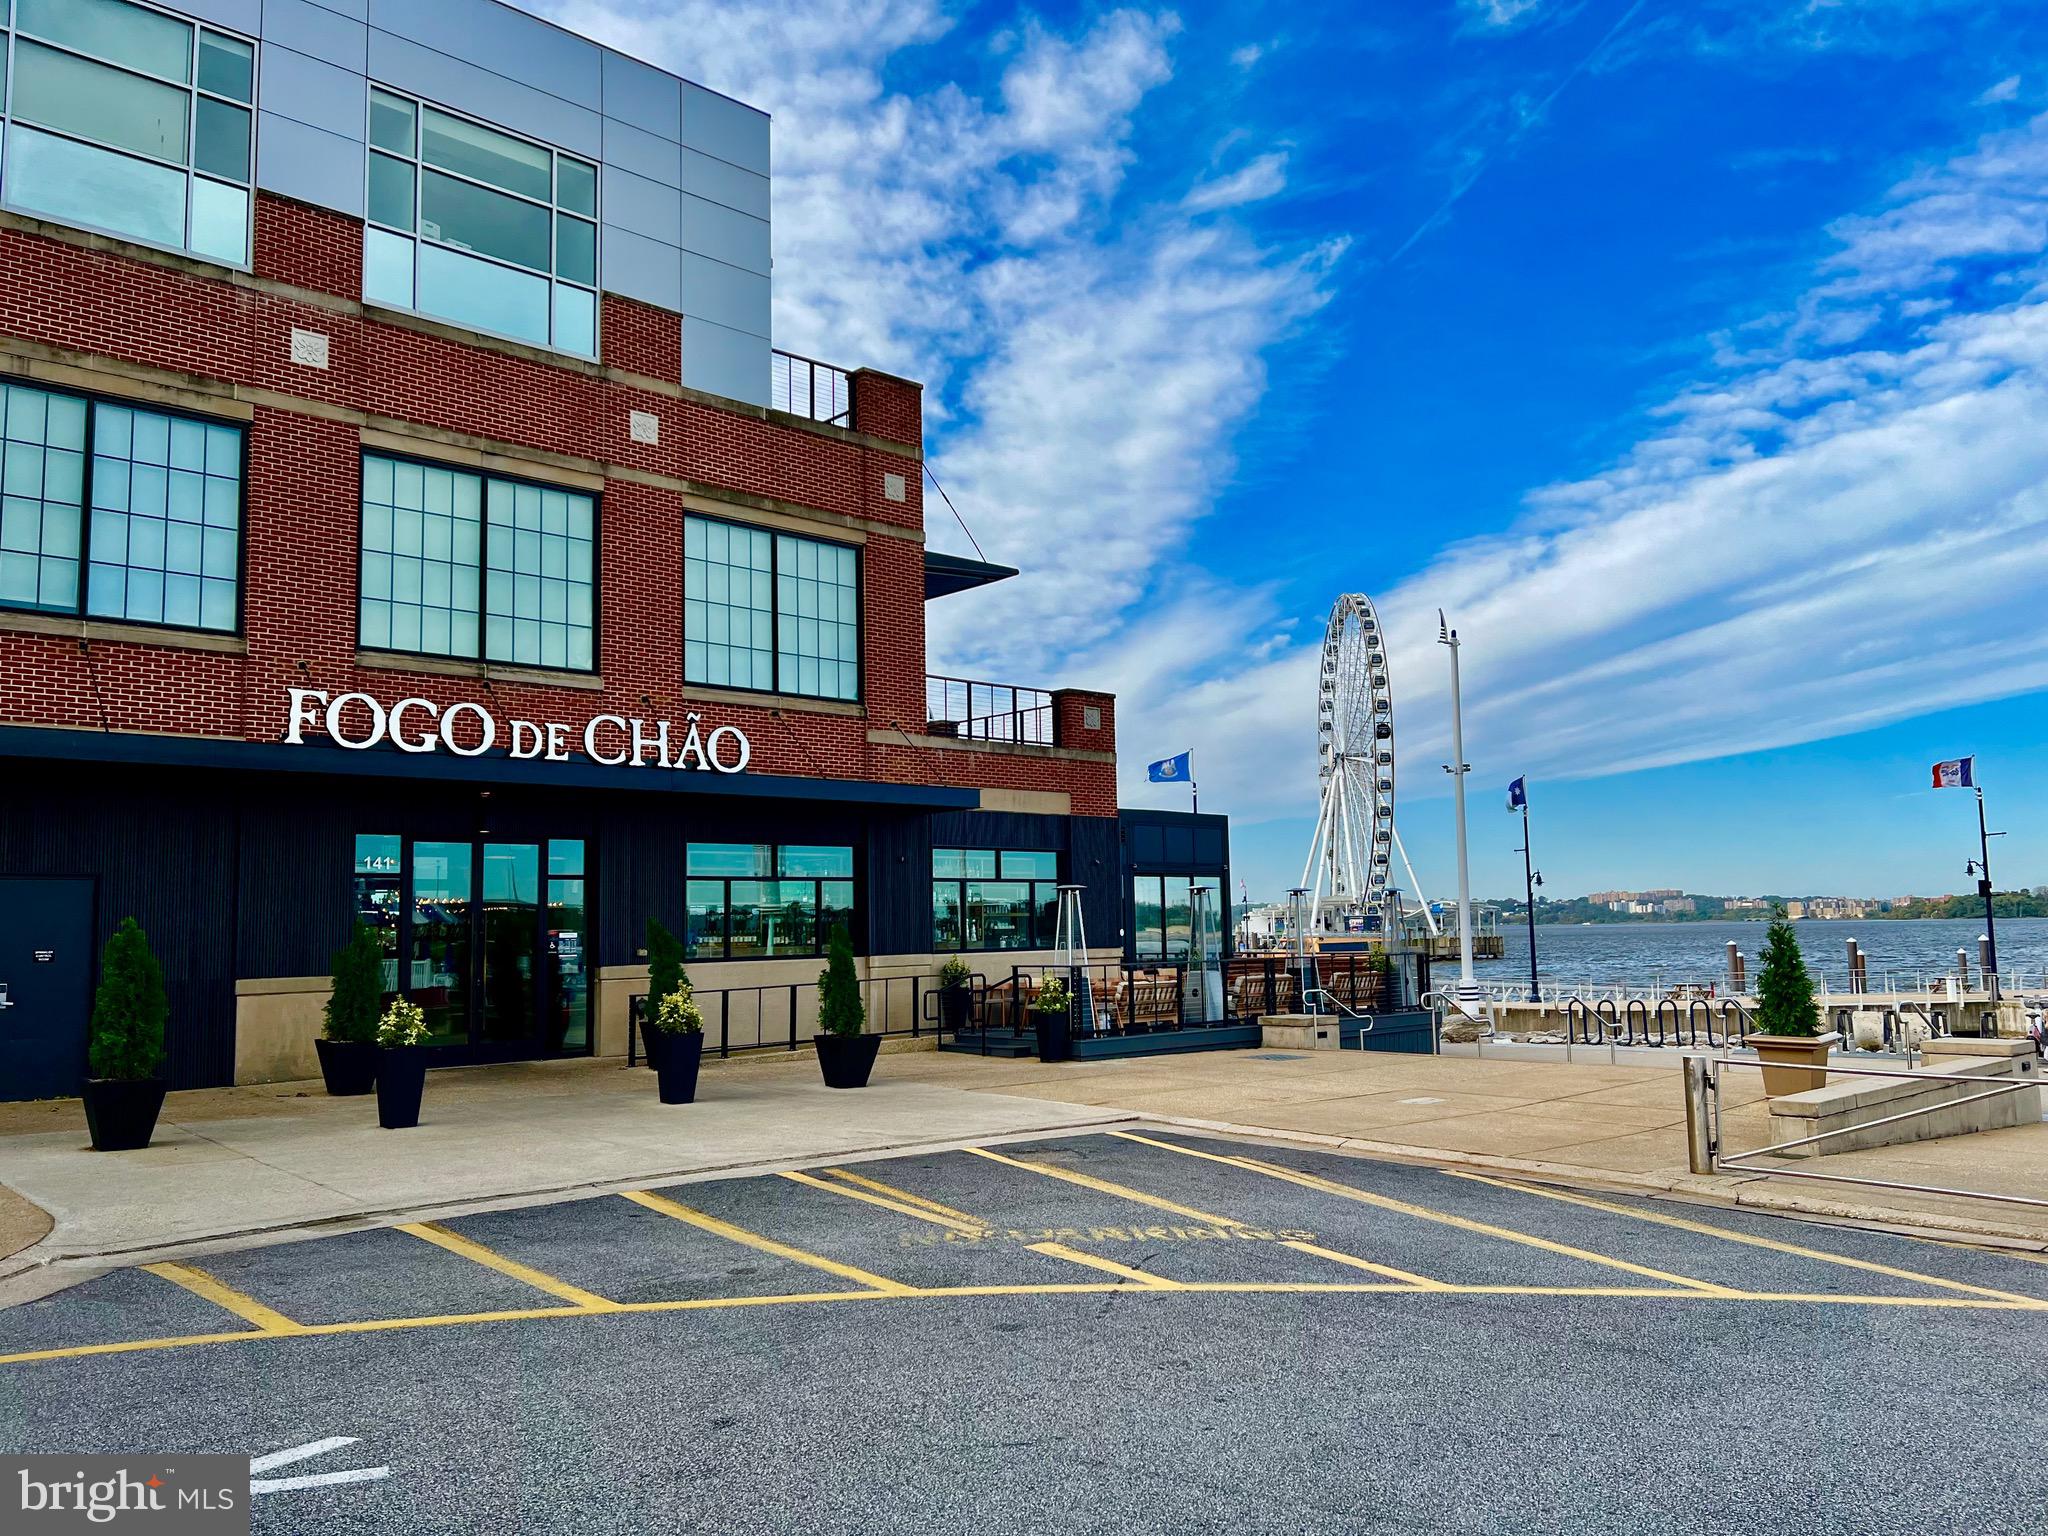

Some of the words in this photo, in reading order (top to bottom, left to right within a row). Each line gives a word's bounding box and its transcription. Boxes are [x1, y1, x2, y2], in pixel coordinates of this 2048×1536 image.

[284, 687, 496, 757] FOGO
[508, 719, 571, 762] DE
[583, 712, 752, 774] CHÃO
[363, 855, 391, 870] 141
